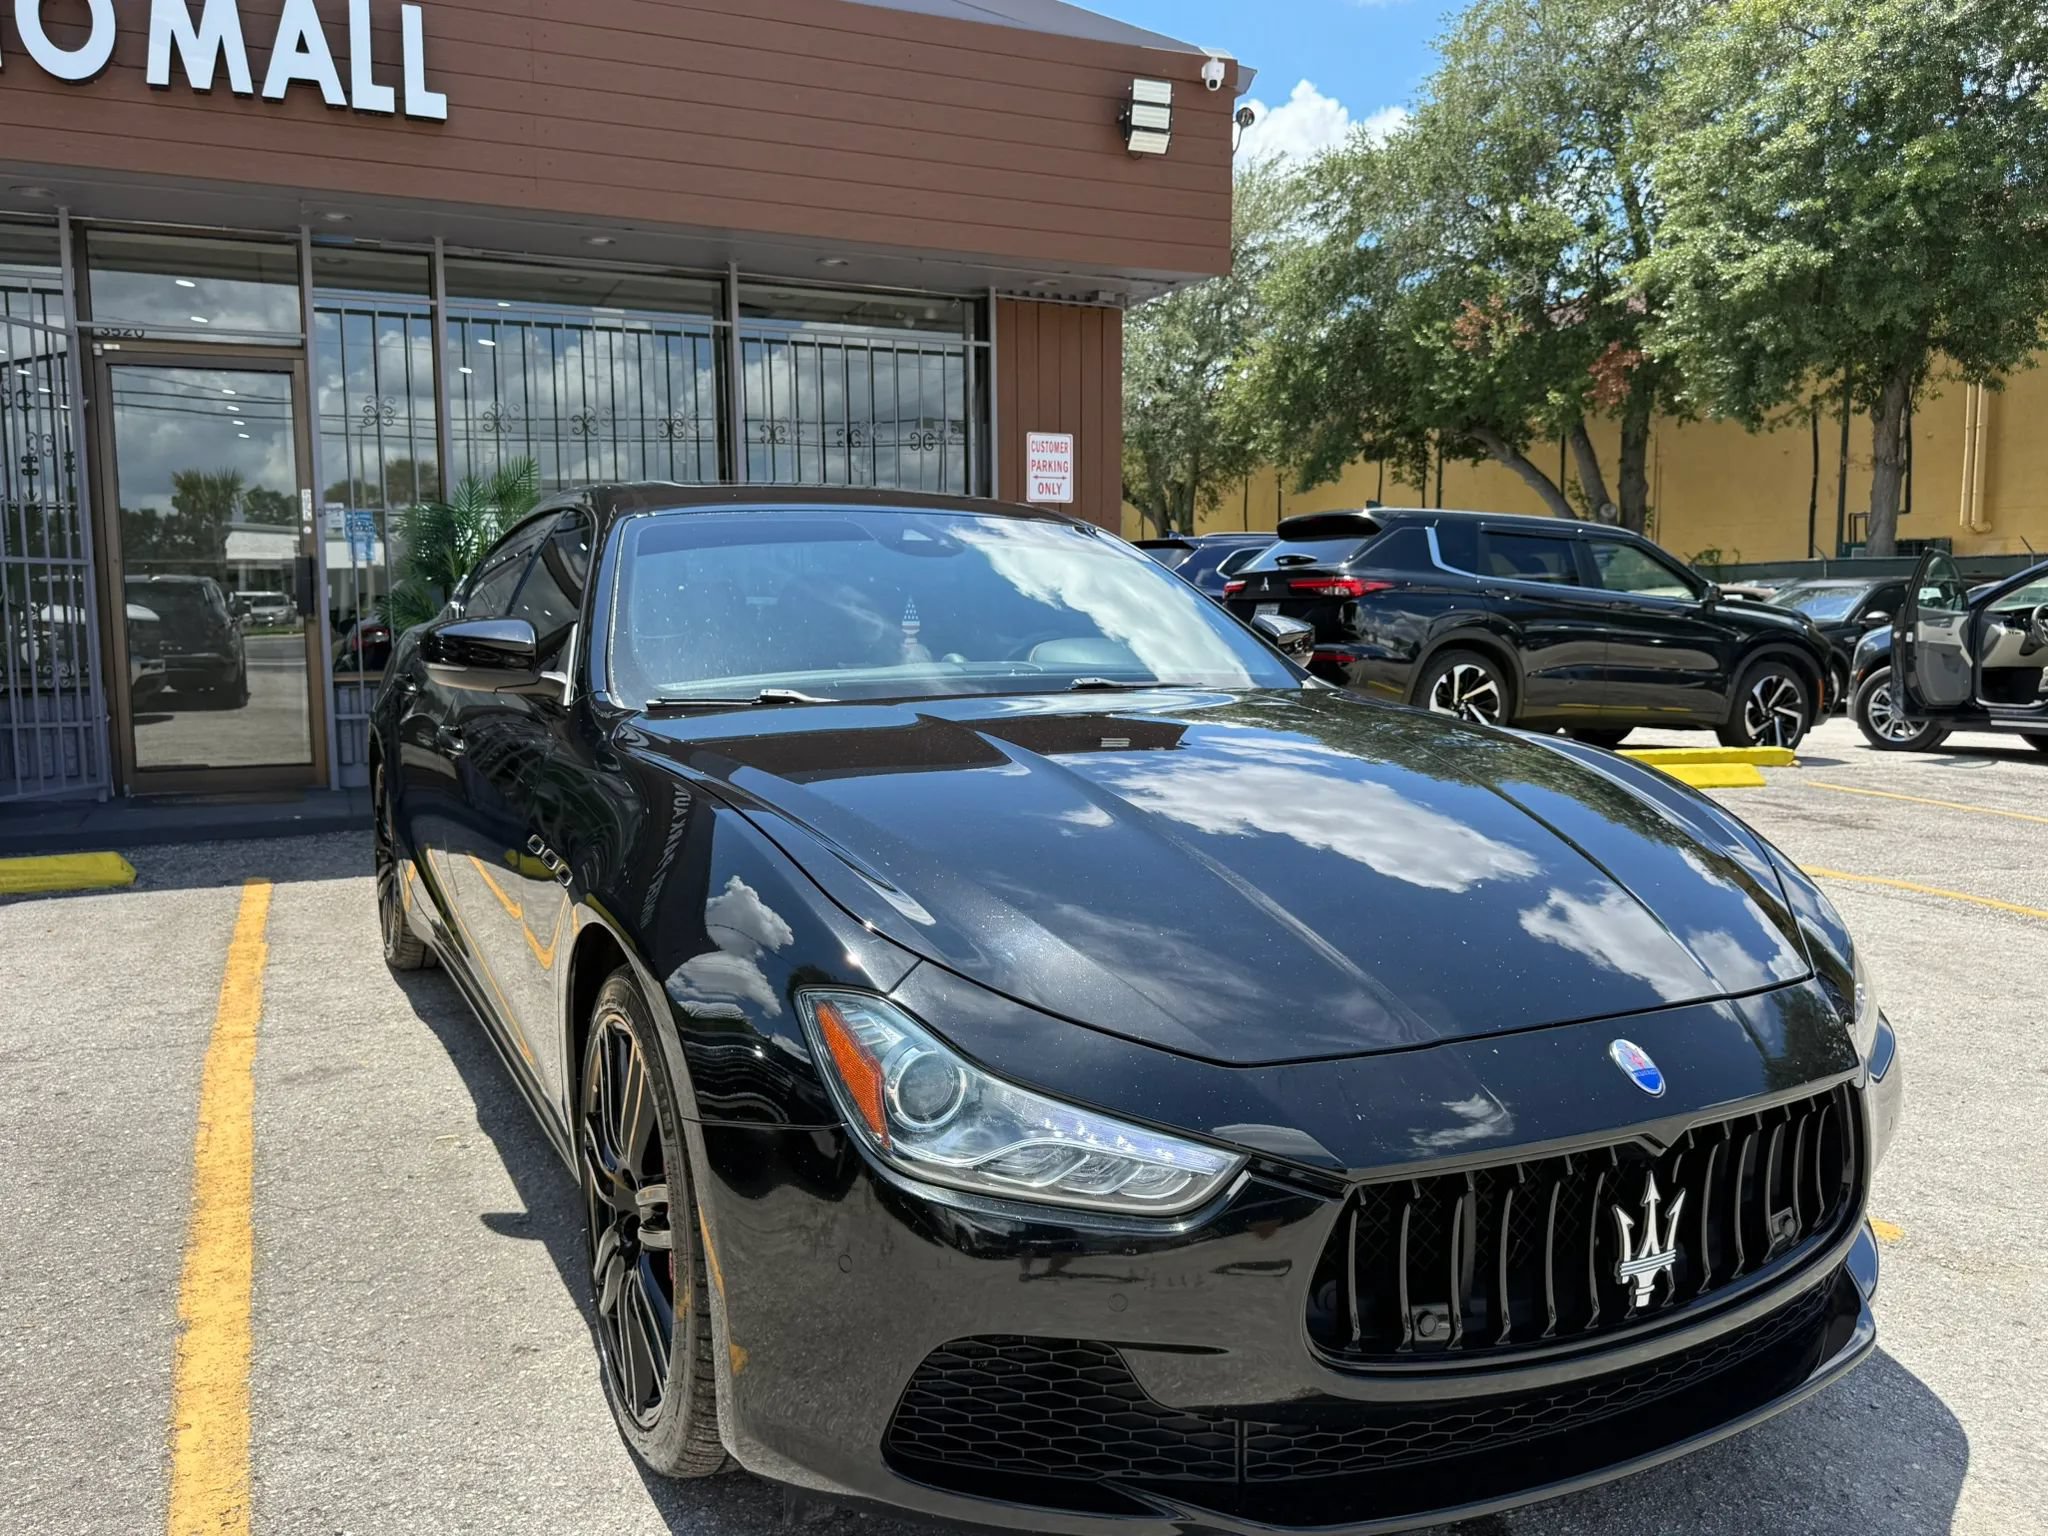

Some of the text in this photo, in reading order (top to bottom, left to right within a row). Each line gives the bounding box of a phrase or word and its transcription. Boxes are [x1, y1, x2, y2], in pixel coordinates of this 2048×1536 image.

[146, 0, 447, 120] MALL
[1031, 440, 1069, 454] CUSTOMER
[1031, 459, 1069, 473] PARKING
[1037, 482, 1062, 496] ONLY
